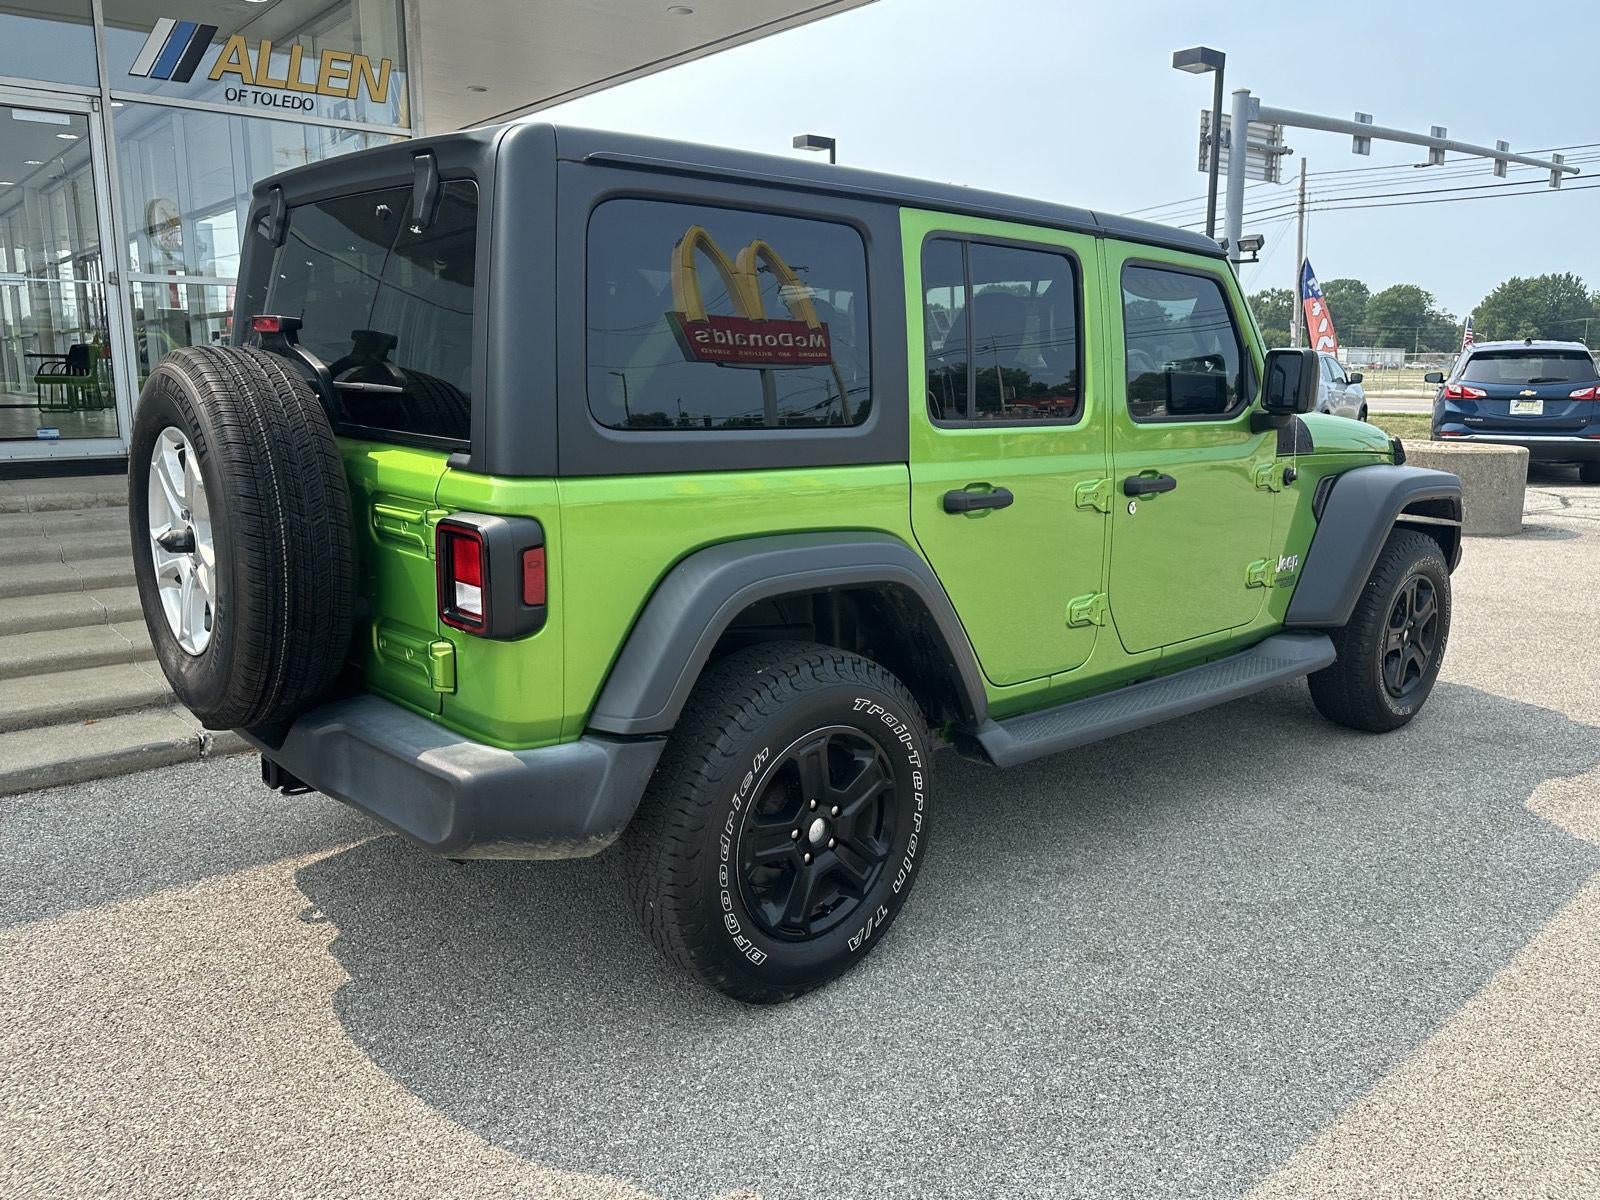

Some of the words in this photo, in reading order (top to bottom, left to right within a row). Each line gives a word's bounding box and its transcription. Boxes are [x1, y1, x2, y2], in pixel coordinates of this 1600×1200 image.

[207, 34, 392, 104] ALLEN
[225, 87, 248, 102] OF
[251, 90, 315, 112] TOLEDO
[1275, 554, 1298, 573] Jeep
[852, 697, 924, 894] Trail-Terrain
[718, 747, 770, 966] BFGoodrich
[847, 904, 889, 952] T/A
